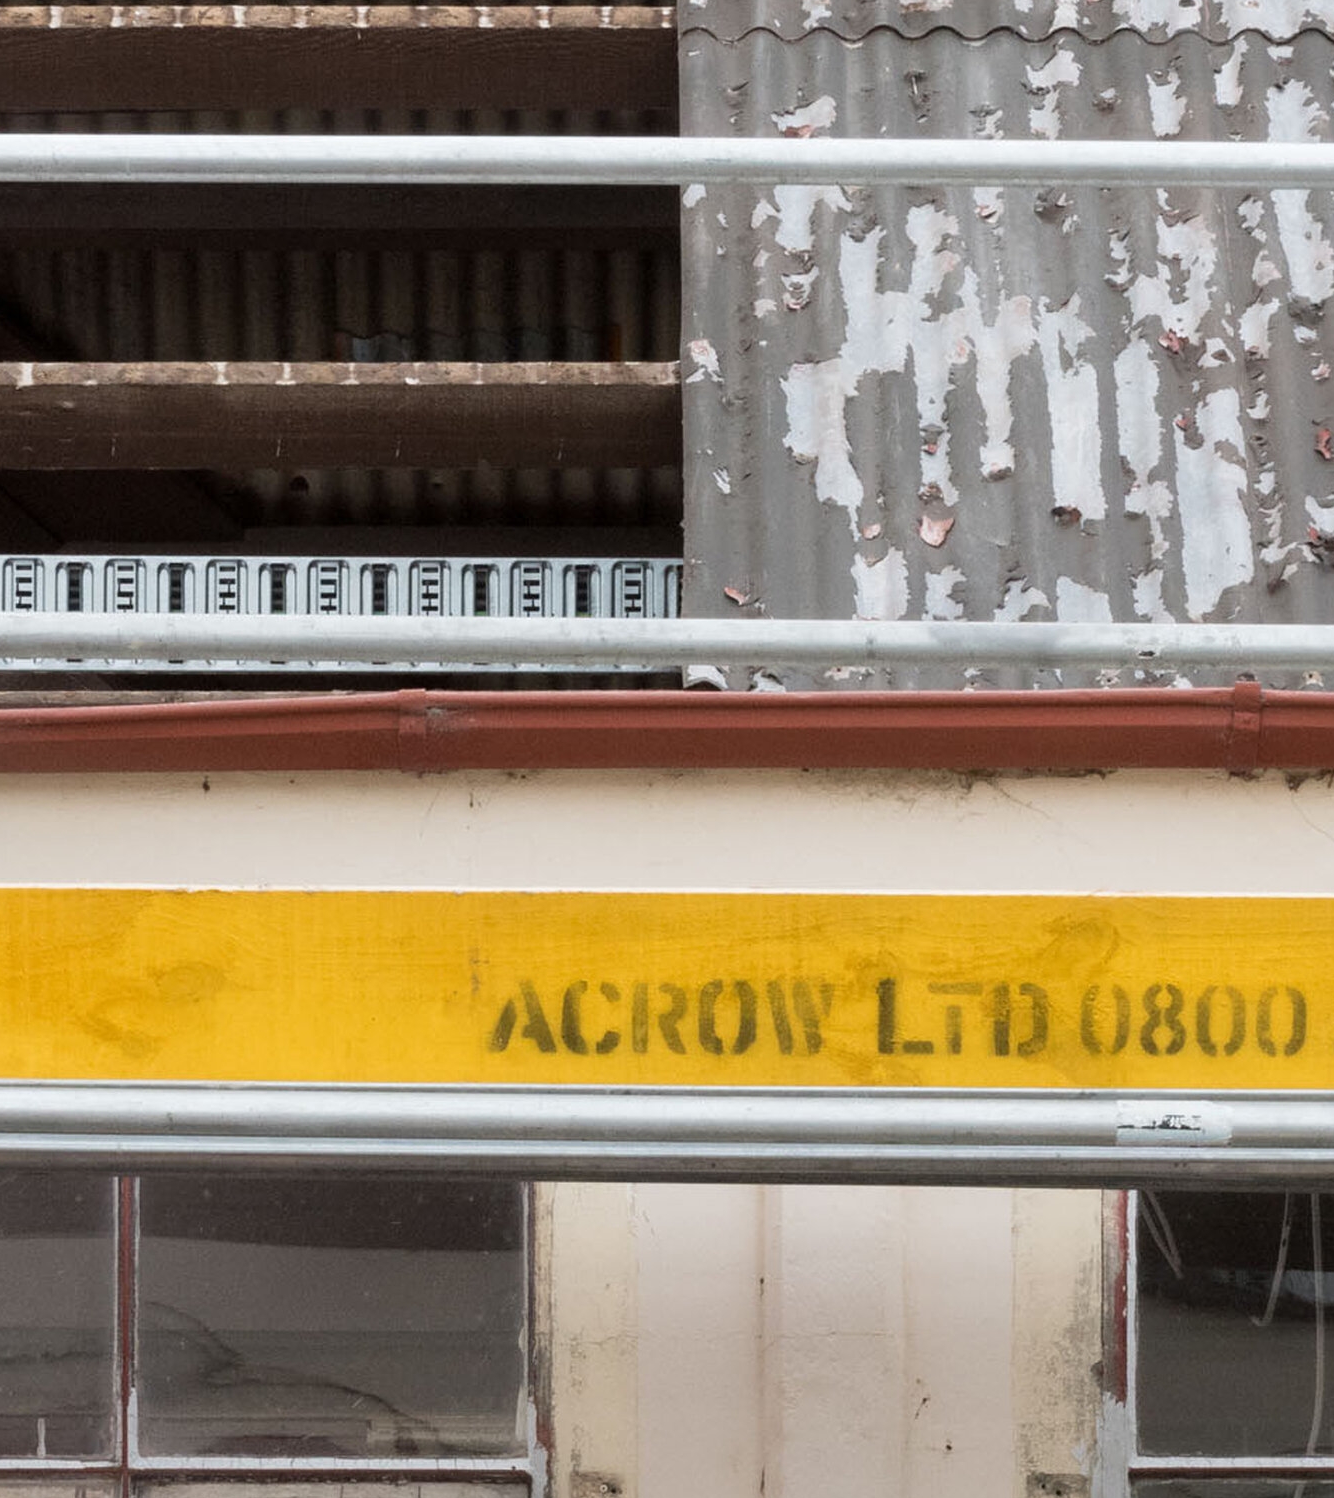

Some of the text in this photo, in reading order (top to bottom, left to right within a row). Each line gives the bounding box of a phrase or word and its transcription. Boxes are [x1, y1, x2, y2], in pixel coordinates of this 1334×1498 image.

[488, 979, 835, 1055] ACROW
[876, 978, 1049, 1056] LTD
[1080, 984, 1307, 1056] 0800
